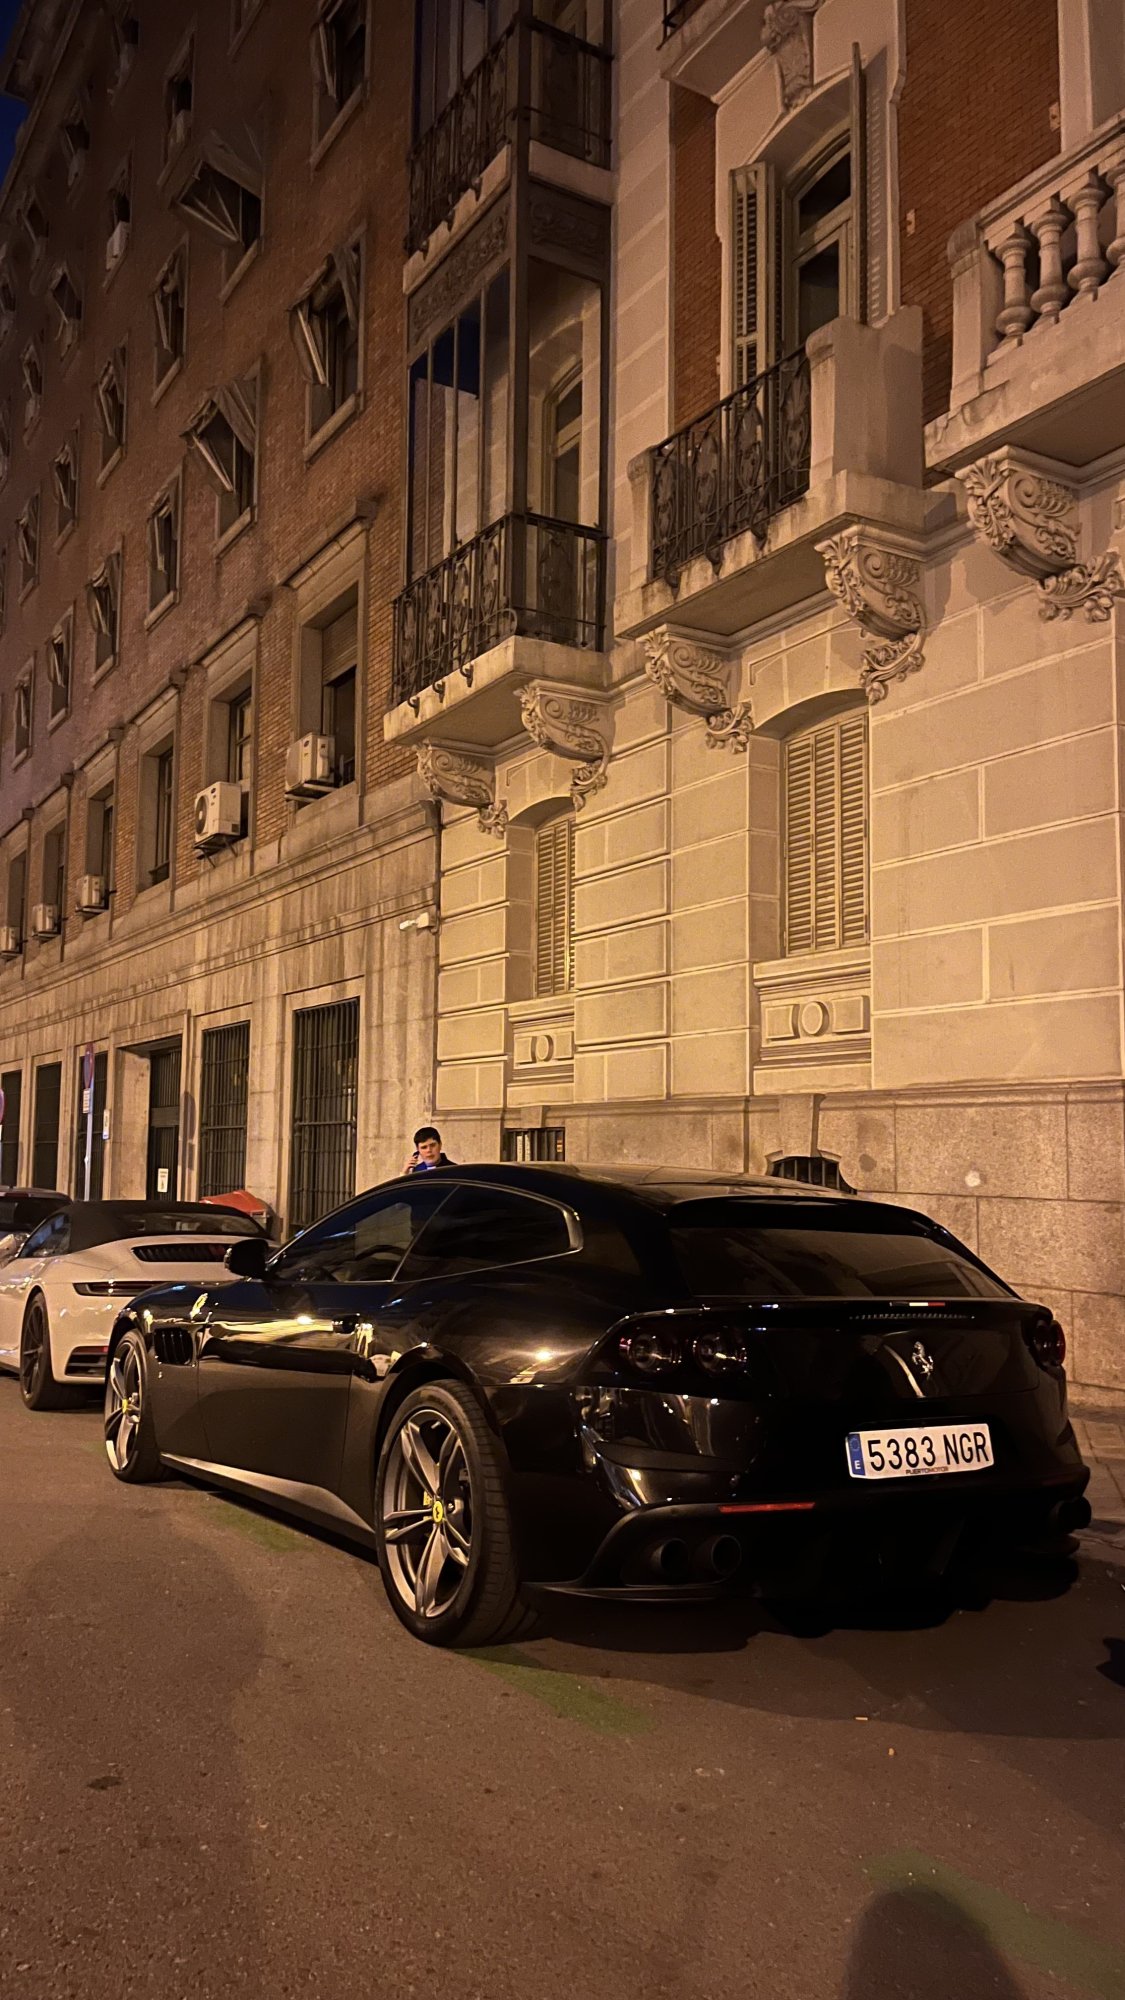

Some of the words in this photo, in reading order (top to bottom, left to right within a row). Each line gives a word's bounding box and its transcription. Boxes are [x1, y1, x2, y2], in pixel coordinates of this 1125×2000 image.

[867, 1435, 936, 1471] 5383
[943, 1431, 990, 1465] NGR
[854, 1460, 861, 1470] E
